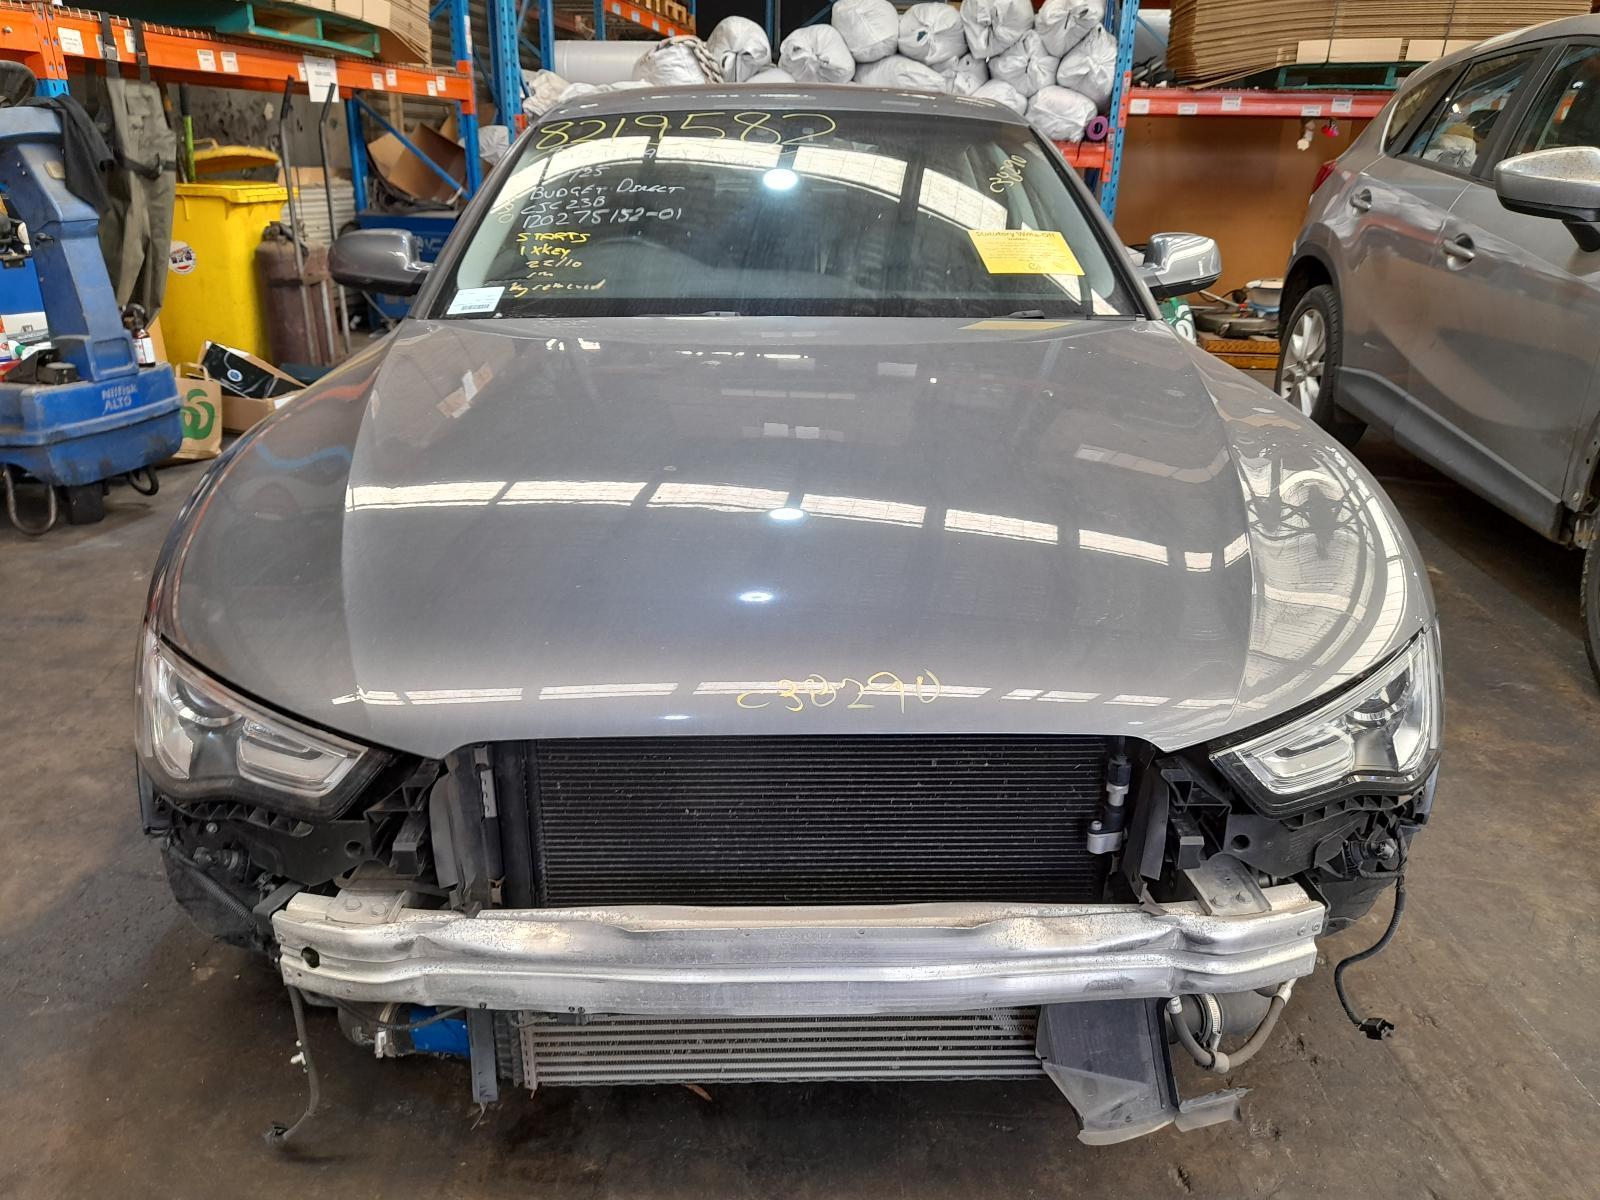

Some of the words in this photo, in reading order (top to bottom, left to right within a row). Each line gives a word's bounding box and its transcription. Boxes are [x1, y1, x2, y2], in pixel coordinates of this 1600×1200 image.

[536, 112, 837, 149] 8219582
[530, 185, 607, 200] BUDGET
[516, 232, 591, 244] STARTS
